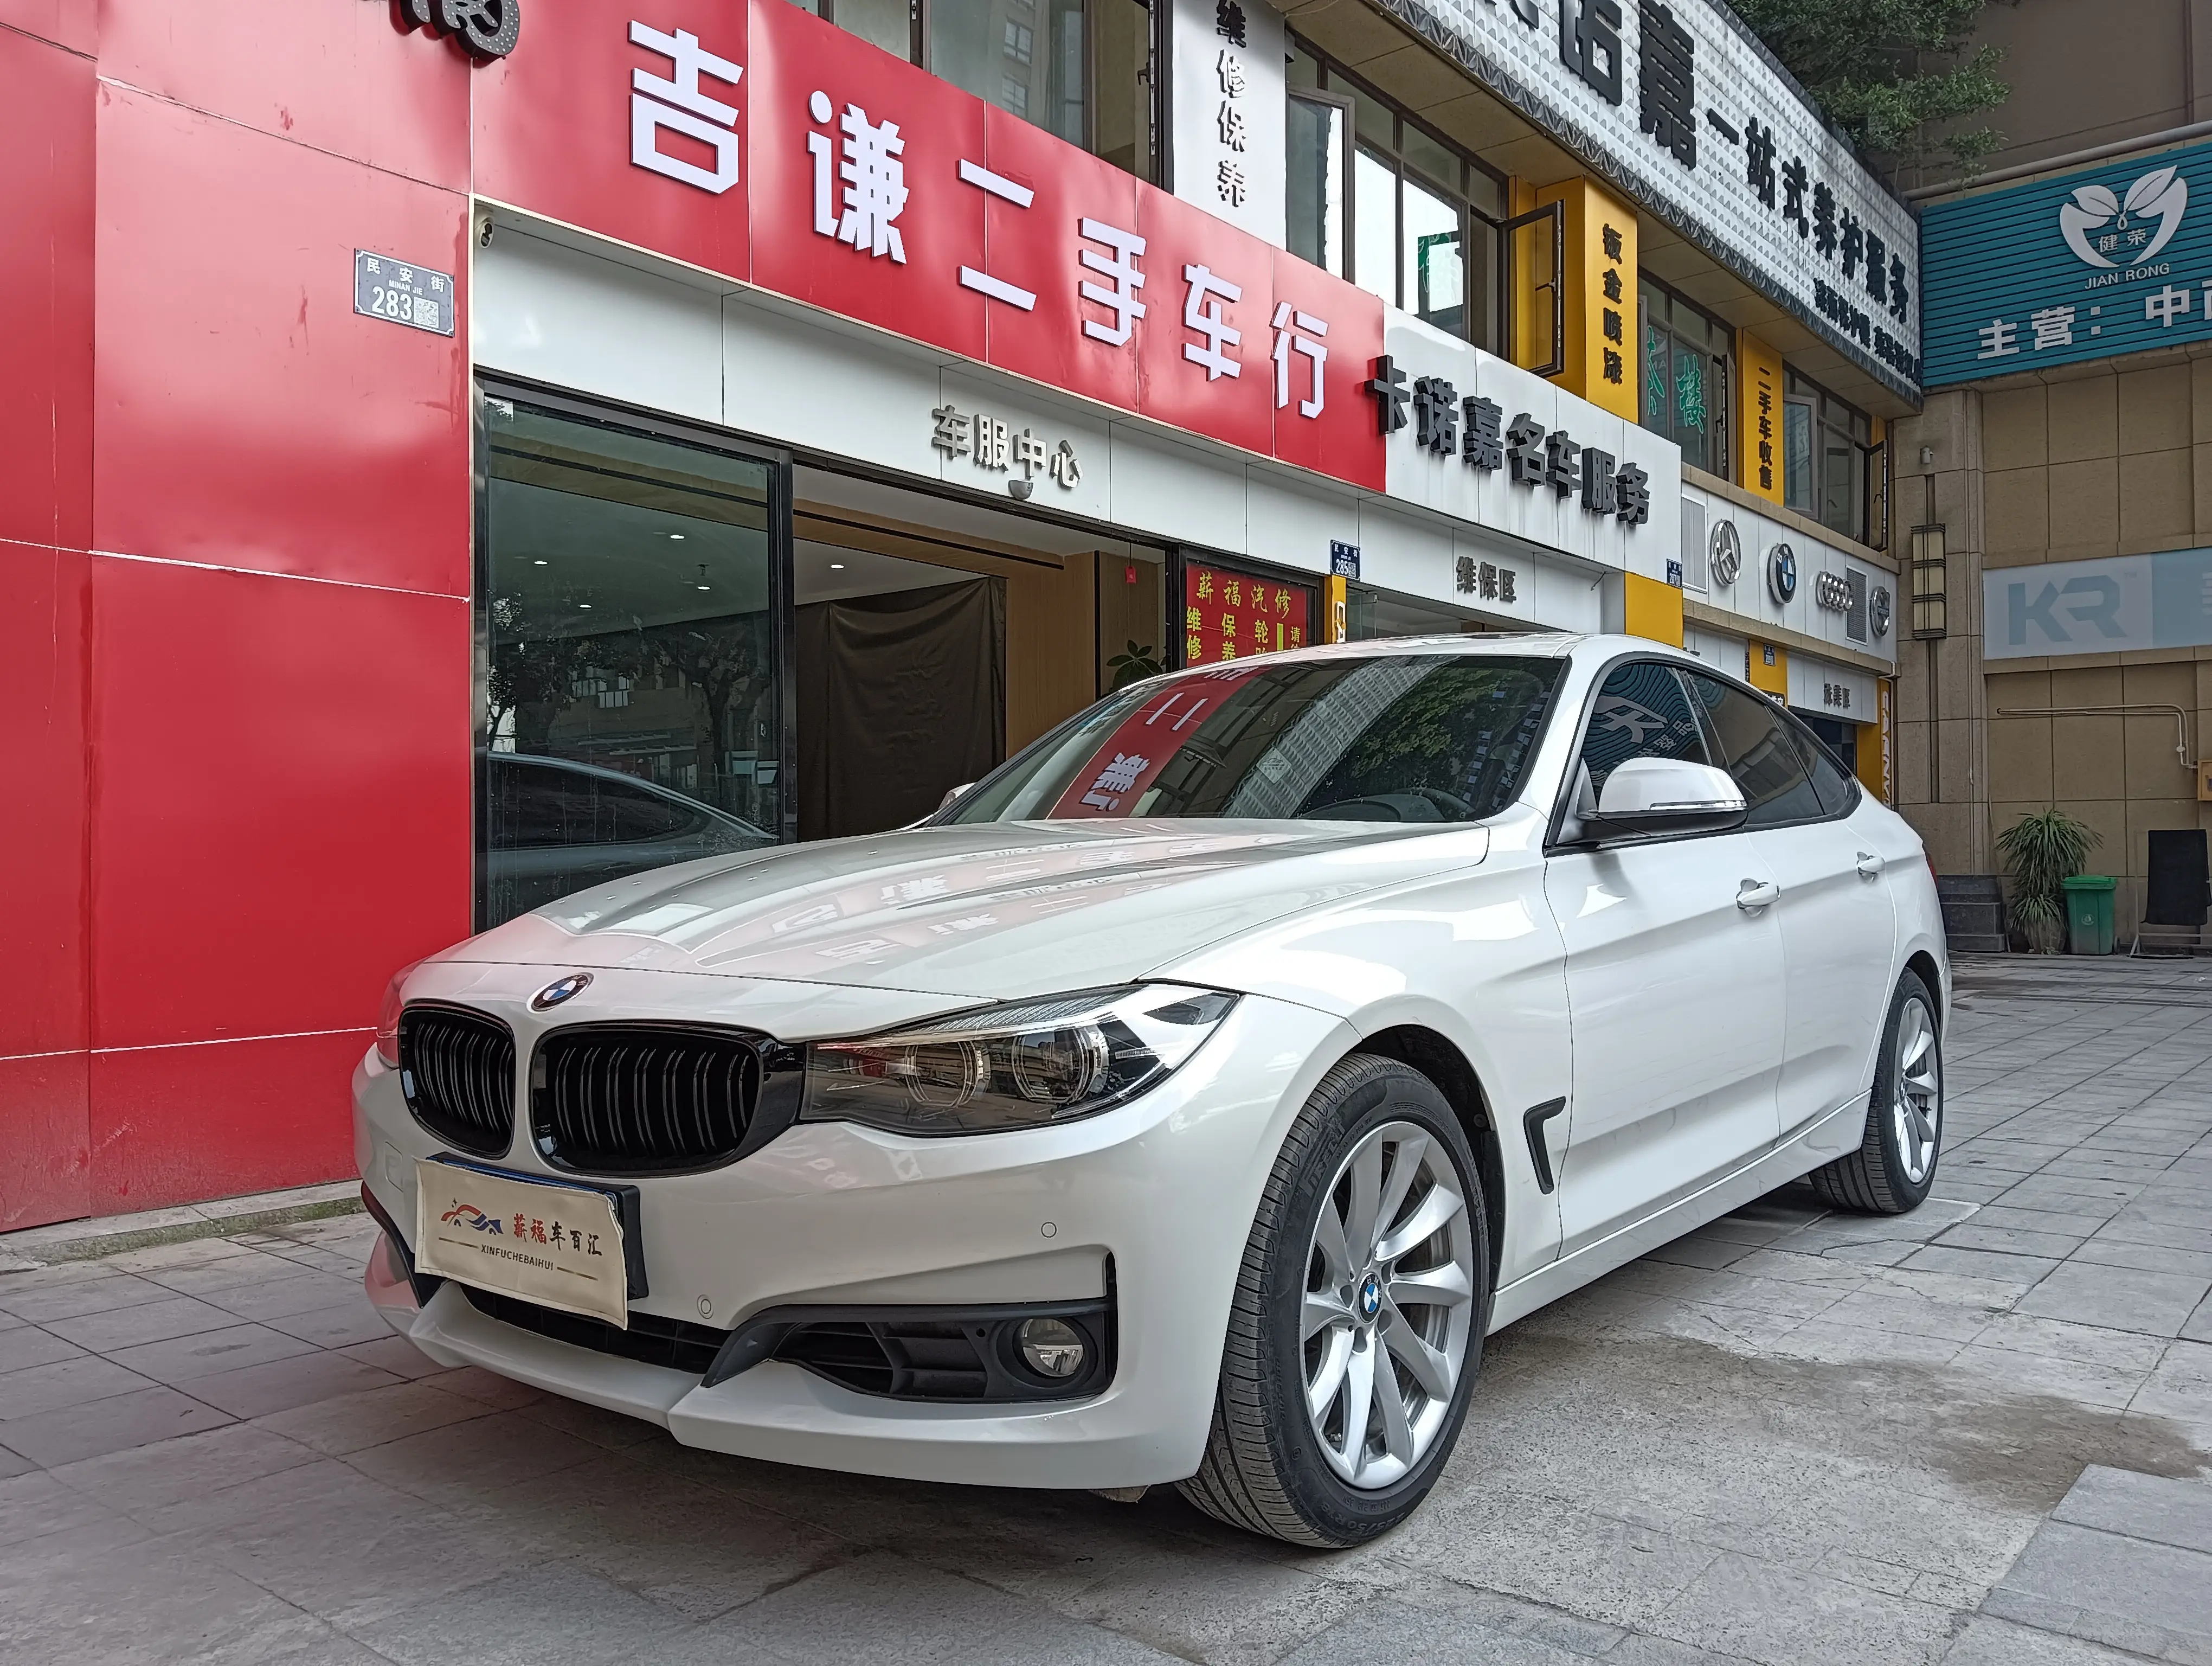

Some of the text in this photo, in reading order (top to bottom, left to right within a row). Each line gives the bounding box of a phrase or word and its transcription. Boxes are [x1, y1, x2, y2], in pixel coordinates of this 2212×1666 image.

[1216, 0, 1247, 207] 维修保养
[629, 20, 1329, 419] 吉谦二手车行
[2099, 228, 2147, 253] 健荣
[366, 257, 445, 293] 民安街
[388, 279, 423, 296] MINAN JIE
[2084, 262, 2170, 290] JIAN RONG
[371, 286, 413, 321] 283
[931, 405, 1084, 489] 车服中心
[1365, 354, 1650, 525] 卡诺嘉名车服务
[1336, 558, 1348, 575] 285
[1456, 556, 1517, 603] 维保区
[2008, 574, 2128, 645] KR
[1186, 606, 1202, 660] 维修
[513, 1213, 603, 1257] 薪福车百汇
[480, 1244, 554, 1271] XINFUCHEBAIHUI
